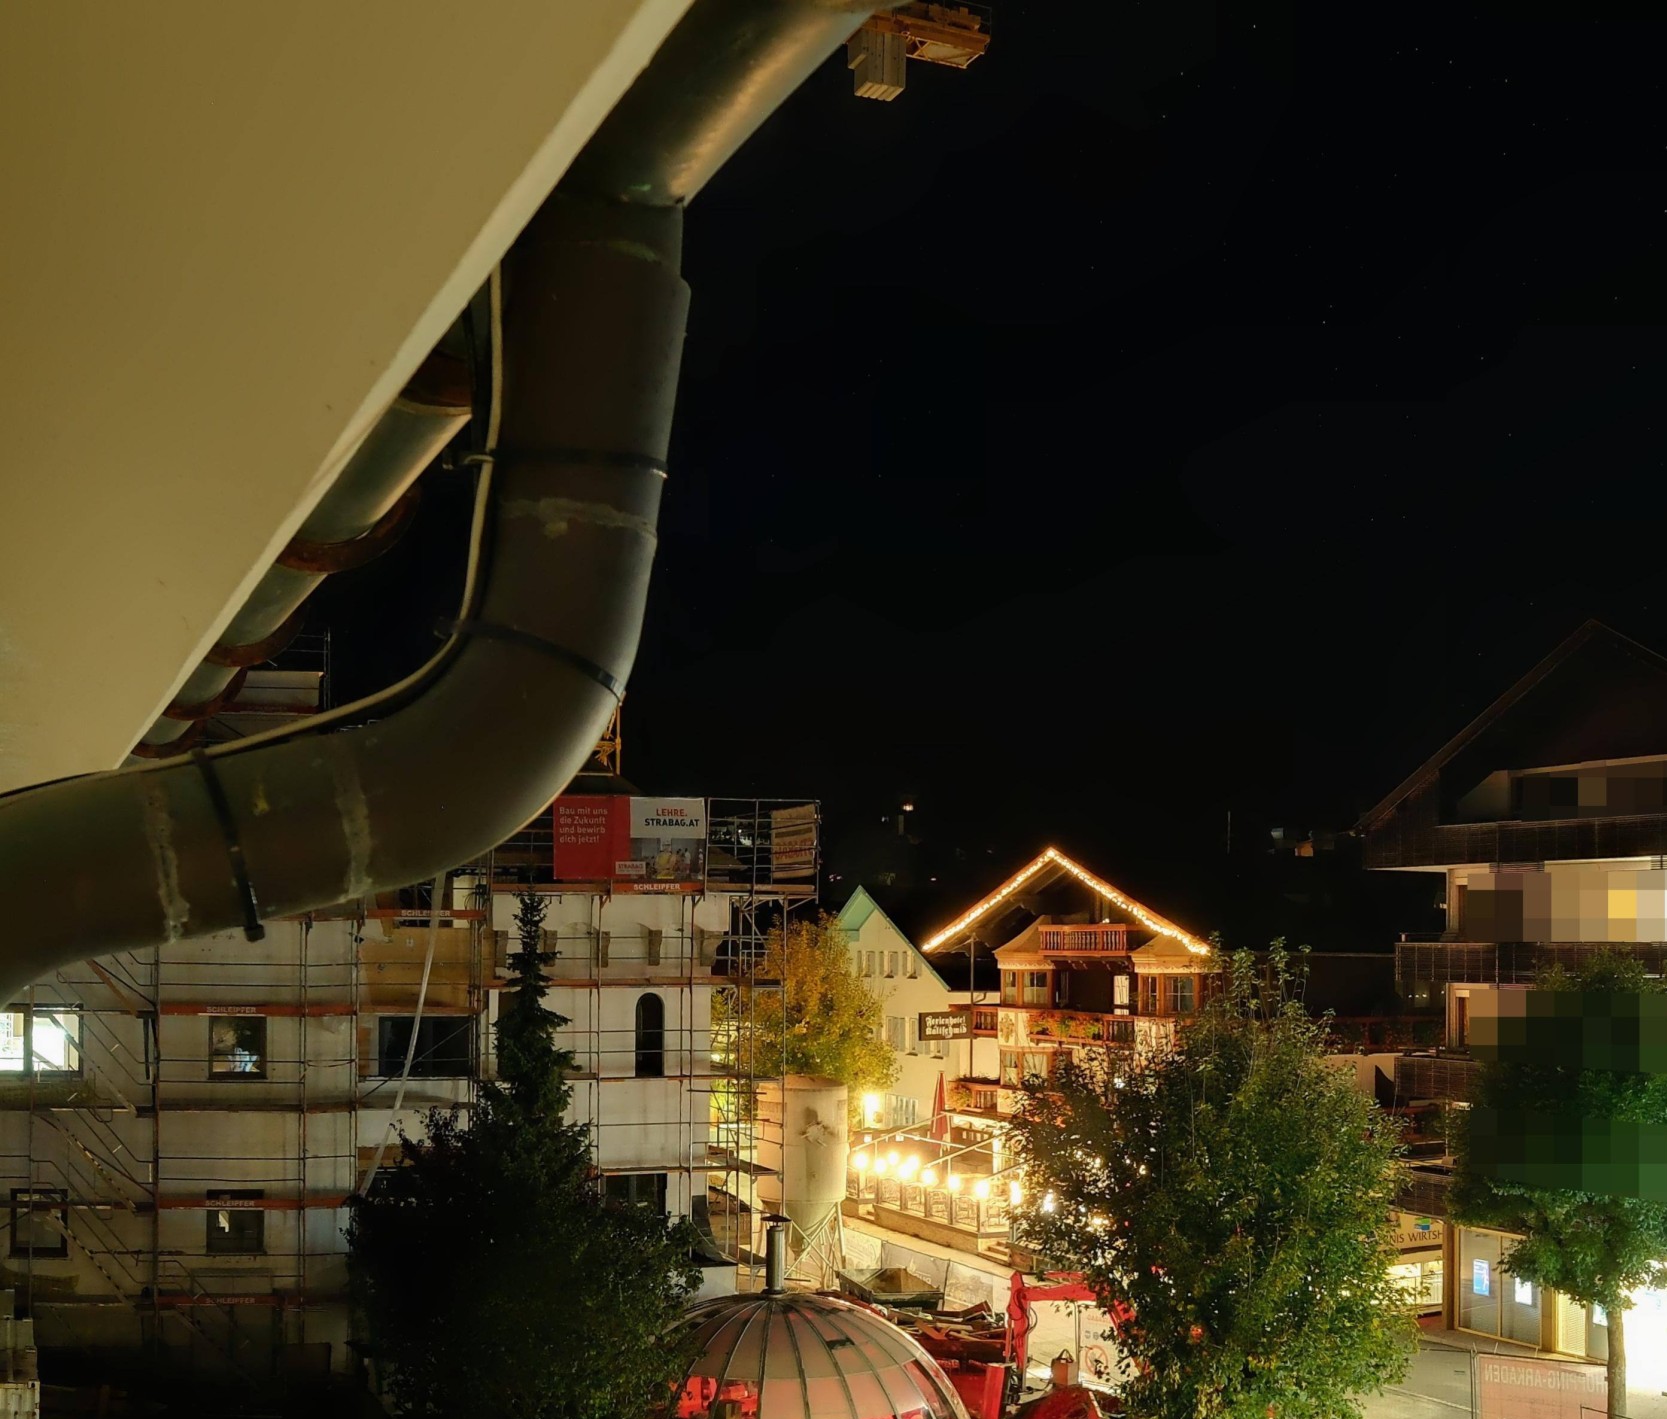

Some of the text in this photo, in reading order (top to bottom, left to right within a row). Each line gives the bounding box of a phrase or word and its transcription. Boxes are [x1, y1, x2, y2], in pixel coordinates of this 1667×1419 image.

[559, 807, 575, 815] Bau
[577, 807, 591, 815] mit
[656, 808, 688, 816] LEHRE.
[559, 816, 606, 825] die Zukunft
[644, 818, 700, 827] STRABAG.AT
[559, 826, 606, 834] und bewirb
[559, 835, 600, 844] dich jetzt!
[401, 909, 451, 917] SCHLEER
